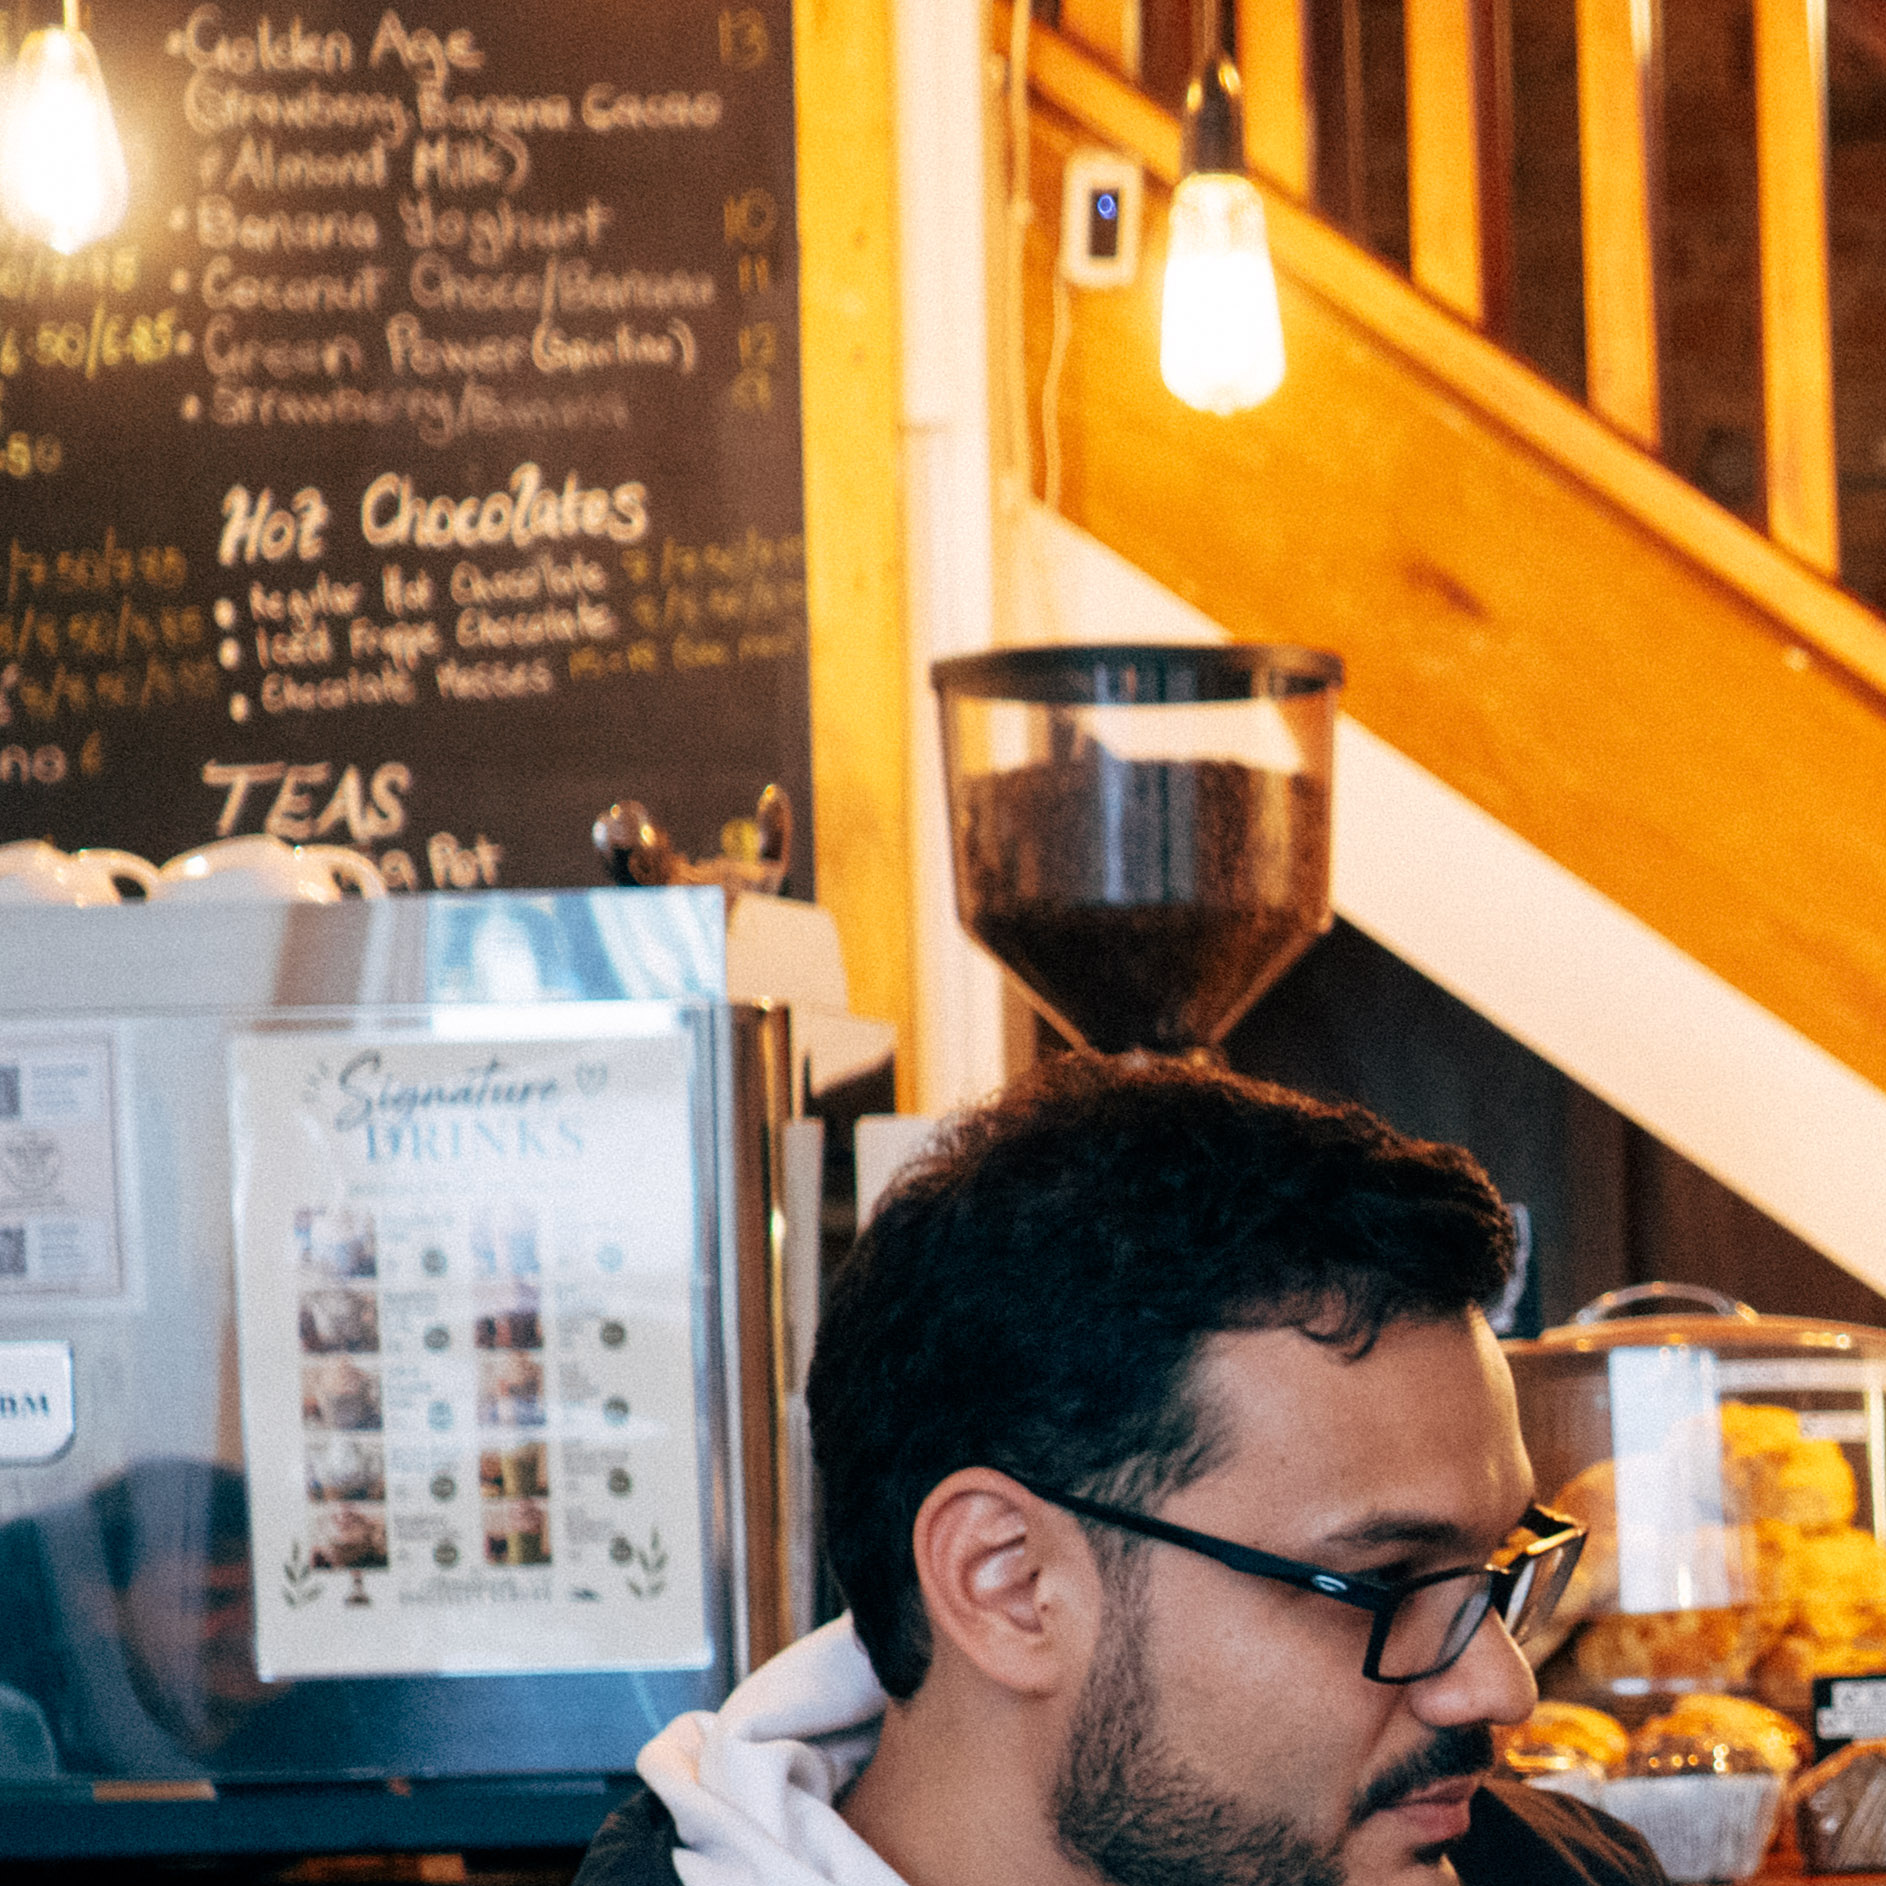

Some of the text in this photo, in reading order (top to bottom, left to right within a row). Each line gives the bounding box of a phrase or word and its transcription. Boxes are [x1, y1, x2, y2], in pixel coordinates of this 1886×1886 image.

[182, 3, 484, 85] Golden Age
[227, 136, 387, 191] Almond
[199, 194, 612, 265] Banana Yoghurt
[201, 258, 384, 311] Coconut
[203, 315, 362, 376] Green
[386, 312, 531, 374] Power
[217, 483, 330, 566] Hot
[361, 461, 650, 553] Chocolates
[249, 571, 362, 633] Regular
[382, 564, 432, 612] Hot
[450, 552, 608, 604] Chocolate
[456, 601, 620, 650] Chocolate
[260, 660, 417, 714] Chocolate
[201, 762, 412, 842] TEAS
[425, 832, 503, 889] Pot
[334, 1048, 559, 1132] Signature
[364, 1114, 585, 1166] DRINKS
